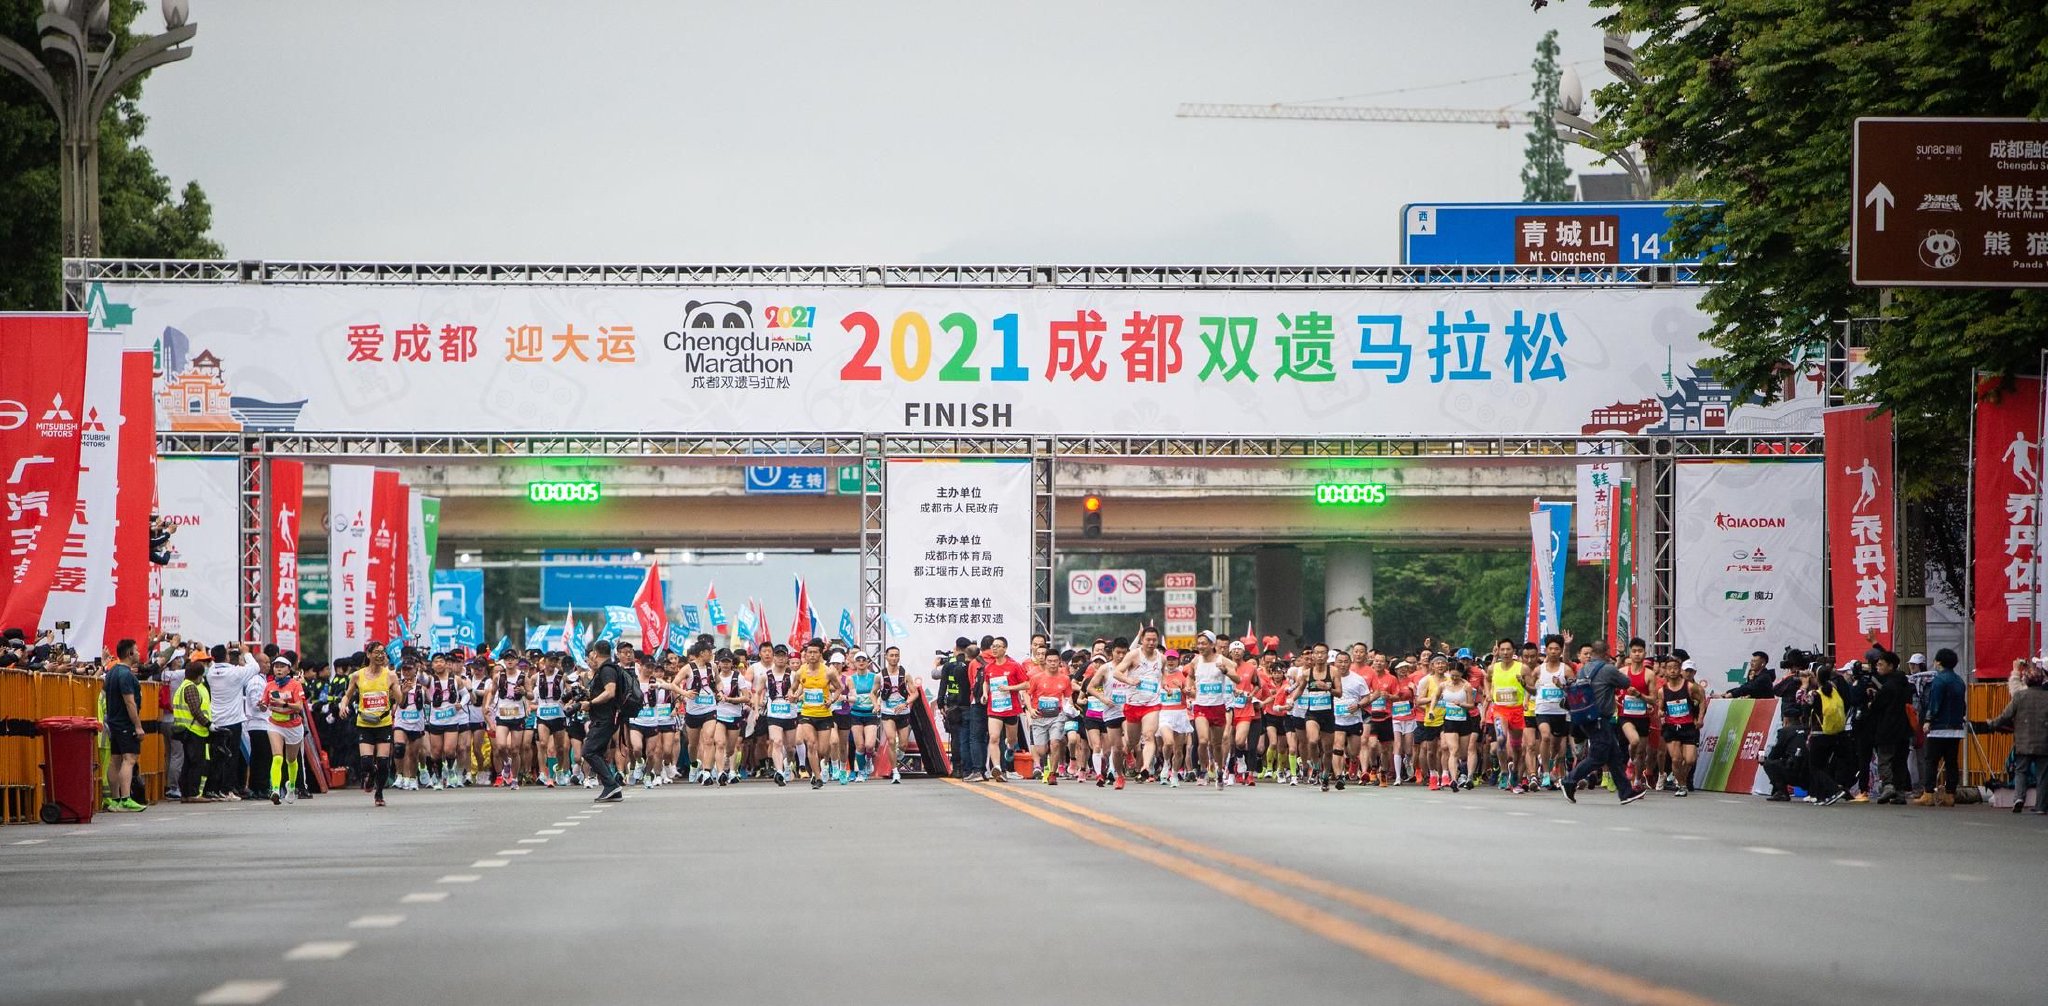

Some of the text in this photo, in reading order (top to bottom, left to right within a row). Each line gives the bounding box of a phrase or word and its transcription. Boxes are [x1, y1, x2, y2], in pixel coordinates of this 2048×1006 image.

[1916, 144, 1945, 156] sunac
[1997, 161, 2038, 171] Chengdu
[1418, 211, 1428, 222] 西
[1997, 210, 2044, 219] Fruit Man
[1522, 220, 1615, 248] 青城山
[1631, 233, 1660, 260] 14
[1983, 231, 2048, 256] 熊猫
[1529, 250, 1606, 265] Mt. Qingcheng
[2013, 260, 2043, 269] Panda
[764, 305, 817, 329] 2021
[347, 324, 636, 363] 爱成都 迎大运
[663, 331, 769, 357] Chengdu
[771, 342, 812, 352] PANDA
[685, 353, 793, 373] Marathon
[691, 375, 791, 389] 成都双遗马拉松
[904, 403, 1013, 427] FINISH
[36, 422, 78, 431] MITSUBISHI
[41, 430, 73, 438] MOTORS
[79, 433, 111, 442] ITSUBISHI
[788, 473, 823, 489] 左转
[530, 483, 599, 502] 00:00:05
[936, 487, 982, 498] 主办单位
[1317, 485, 1385, 503] 00:00:05
[920, 503, 999, 513] 成都市人民政府
[164, 515, 200, 526] ODAN
[1727, 518, 1785, 528] QIAODAN
[936, 535, 982, 545] 承办单位
[925, 551, 992, 561] 成都市体育局
[2004, 493, 2042, 622] 乔丹体育
[913, 566, 1004, 577] 都江堰市人民政府
[1167, 576, 1193, 587] G317
[170, 589, 189, 598] 魔力
[1754, 591, 1773, 600] 魔力
[924, 597, 992, 608] 赛事运营单位
[608, 611, 636, 623] 230
[1168, 607, 1194, 618] G350
[913, 613, 1004, 624] 万达体育成都双遗
[1746, 618, 1766, 626] 京东
